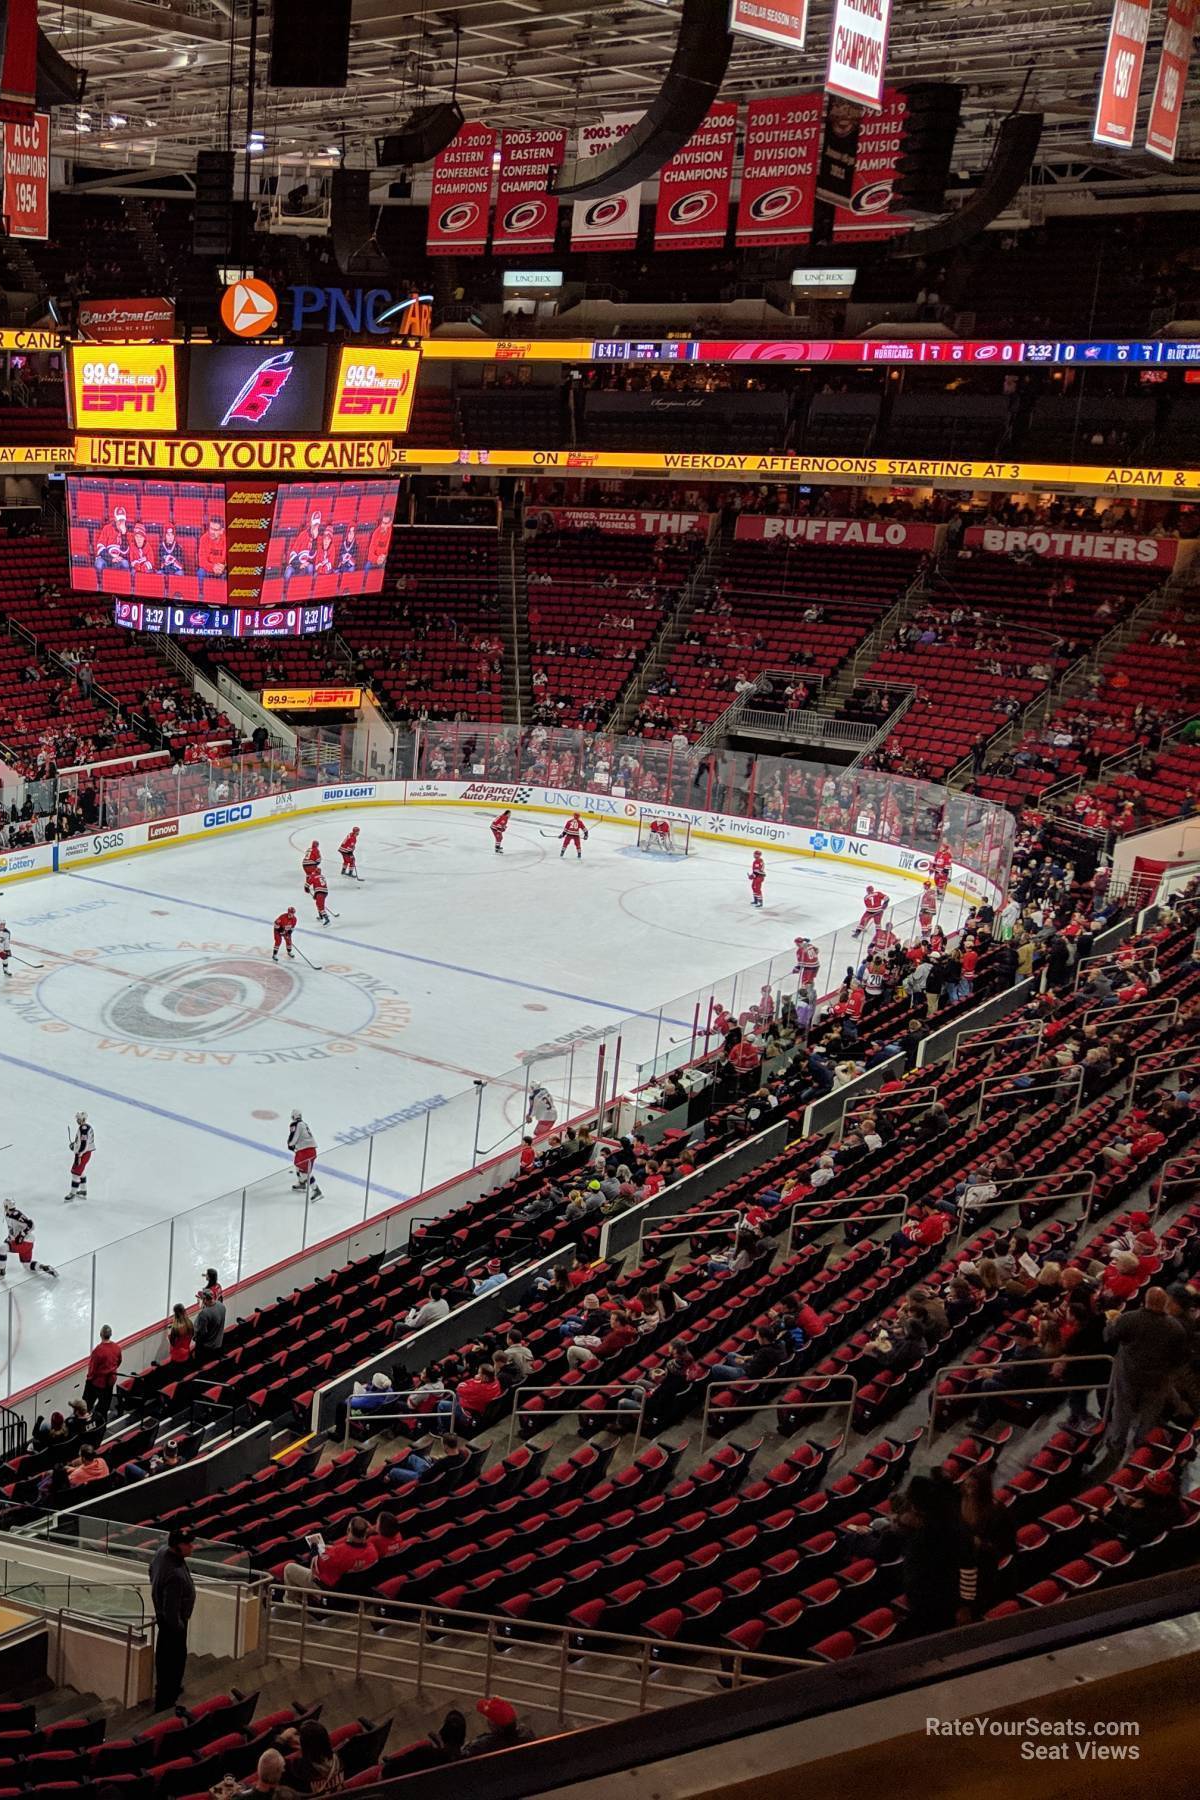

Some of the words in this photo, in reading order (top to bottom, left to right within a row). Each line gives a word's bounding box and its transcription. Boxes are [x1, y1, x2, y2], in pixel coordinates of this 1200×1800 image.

[739, 1, 766, 19] REGULAR
[766, 9, 790, 25] SEASON
[834, 25, 882, 78] CHAMPIONS
[750, 110, 818, 126] 2001-2002
[13, 122, 40, 149] ACC
[505, 131, 563, 145] 2005-2006
[749, 127, 817, 144] SOUTHEAST
[444, 151, 484, 163] EASTERN
[510, 148, 554, 160] EASTERN
[672, 150, 723, 165] DIVISION
[754, 146, 807, 161] DIVISION
[7, 154, 47, 180] CHAMPIONS
[436, 166, 489, 179] CONFERENCE
[744, 162, 813, 179] CHAMPIONS
[663, 167, 728, 183] CHAMPIONS
[434, 181, 488, 194] CHAMPIONS
[15, 183, 37, 213] 1954
[515, 274, 532, 283] UNC
[533, 274, 552, 283] REX
[804, 272, 824, 282] UNC
[825, 272, 844, 282] REX
[117, 311, 143, 323] STAR
[144, 310, 174, 322] GAME
[287, 285, 391, 335] PNC
[598, 343, 617, 357] 6:41
[874, 349, 913, 359] HURRICANES
[952, 350, 962, 359] 0
[1001, 345, 1013, 360] 0
[1027, 345, 1052, 357] 3:32
[1064, 345, 1075, 360] 0
[1117, 350, 1127, 360] 0
[1167, 349, 1185, 360] BLUE
[83, 362, 119, 385] 99.9
[345, 365, 376, 387] 99.9
[82, 385, 155, 412] ESPN
[338, 387, 399, 415] ESPN
[24, 448, 75, 463] AFTERN
[90, 438, 156, 465] LISTEN
[165, 441, 204, 467] TO
[213, 442, 295, 468] YOUR
[304, 442, 374, 468] CANES
[533, 452, 559, 465] ON
[664, 454, 748, 469] WEEKDAY
[757, 456, 878, 474] AFTERNOONS
[887, 461, 973, 477] STARTING
[983, 463, 1006, 477] AT
[1009, 464, 1020, 478] 3
[1105, 468, 1163, 486] ADAM
[1173, 471, 1188, 487] &
[599, 512, 627, 521] PIZZA
[627, 513, 636, 521] &
[640, 513, 699, 534] THE
[764, 517, 906, 545] BUFFALO
[983, 529, 1159, 562] BROTHERS
[131, 604, 138, 621] 0
[145, 608, 164, 624] 3:32
[174, 609, 184, 626] 0
[222, 614, 229, 626] 0
[245, 614, 252, 626] 0
[287, 610, 296, 627] 0
[304, 609, 319, 625] 3:32
[179, 627, 194, 635] BLUE
[195, 627, 223, 635] JACKETS
[253, 628, 289, 636] HURRICANES
[267, 695, 287, 705] 99.9
[311, 690, 354, 703] ESPN
[324, 788, 344, 800] BUD
[344, 786, 374, 798] LIGHT
[459, 790, 482, 801] Auto
[482, 791, 513, 803] Parts
[467, 783, 515, 796] Advance
[544, 791, 581, 808] UNC
[584, 797, 618, 815] REX
[203, 804, 252, 828] GEICO
[150, 824, 177, 838] Lenovo
[729, 818, 786, 841] invisalign
[848, 841, 869, 857] NC
[8, 858, 35, 871] Lottery
[898, 857, 913, 870] LIVE
[868, 896, 875, 905] 7
[869, 974, 882, 986] 20
[334, 1094, 449, 1146] ticketmaster
